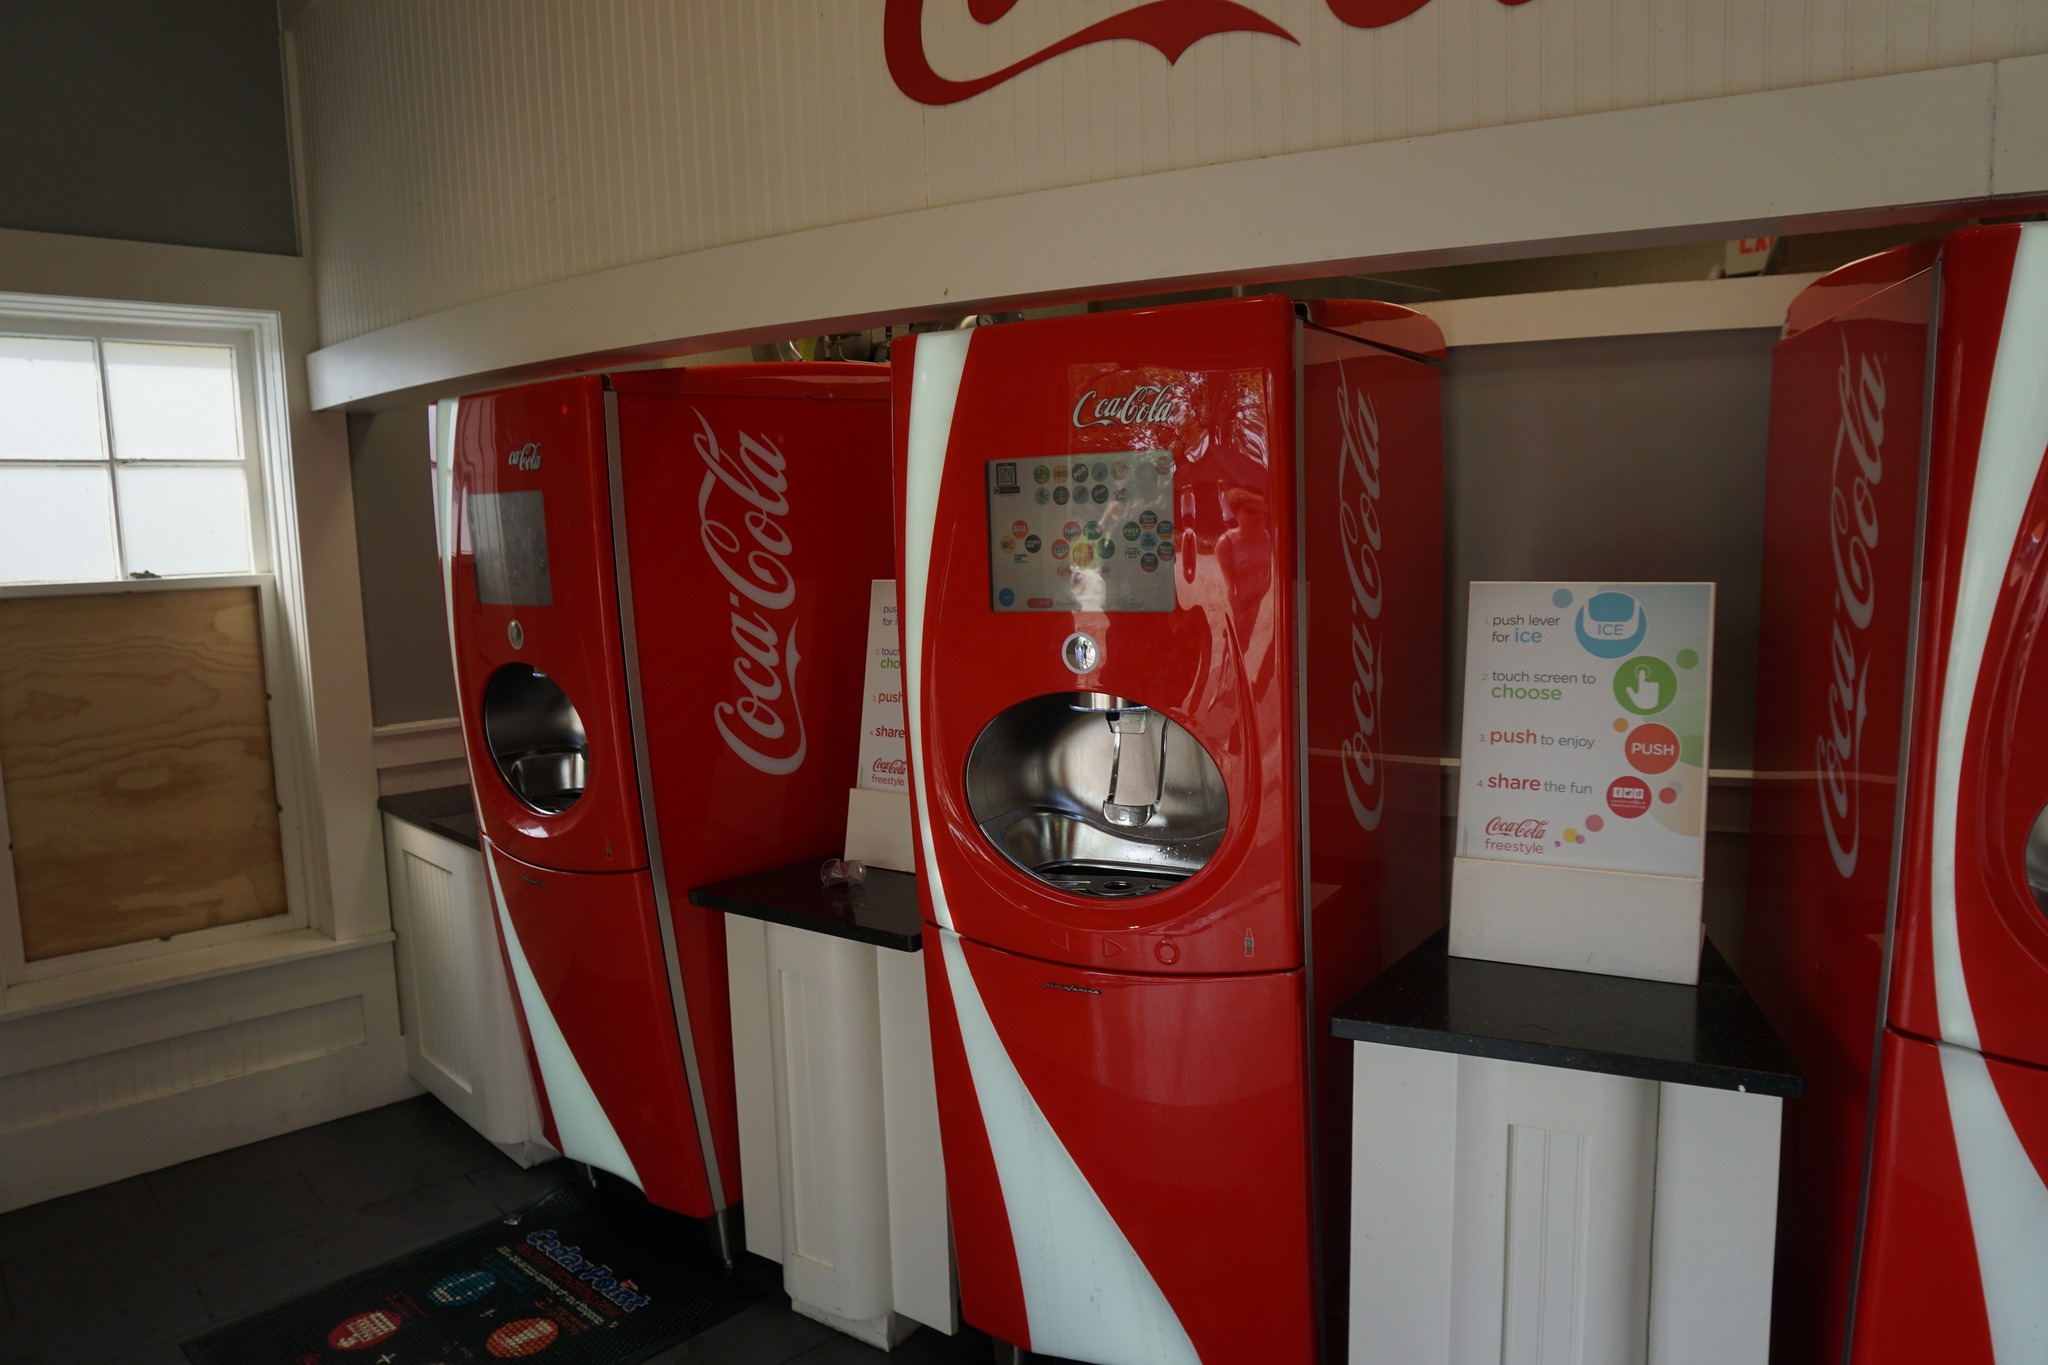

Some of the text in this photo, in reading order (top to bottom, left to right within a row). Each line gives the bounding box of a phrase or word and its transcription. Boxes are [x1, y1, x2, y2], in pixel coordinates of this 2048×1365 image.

[691, 404, 806, 775] Coca-Cola
[1336, 355, 1385, 831] Coca-Cola
[883, 606, 898, 616] pus
[883, 617, 893, 626] for
[1492, 614, 1524, 628] push
[1529, 614, 1561, 627] lever
[1492, 627, 1542, 643] for ice
[1597, 624, 1625, 636] ICE
[1492, 670, 1530, 682] touch
[1533, 673, 1578, 684] screen
[1582, 673, 1597, 684] to
[1491, 682, 1562, 701] choose
[875, 725, 905, 739] share
[1490, 728, 1537, 745] push
[1541, 734, 1555, 745] to
[1558, 734, 1596, 750] enjoy
[1631, 742, 1675, 756] PUSH
[872, 773, 904, 788] freestyle
[1487, 773, 1541, 791] share
[1544, 780, 1566, 793] the
[1570, 781, 1593, 795] fun
[1485, 816, 1551, 839] Coca-Cola
[1485, 838, 1545, 856] freestyle
[526, 1228, 596, 1273] Cedar
[578, 1264, 653, 1314] Point
